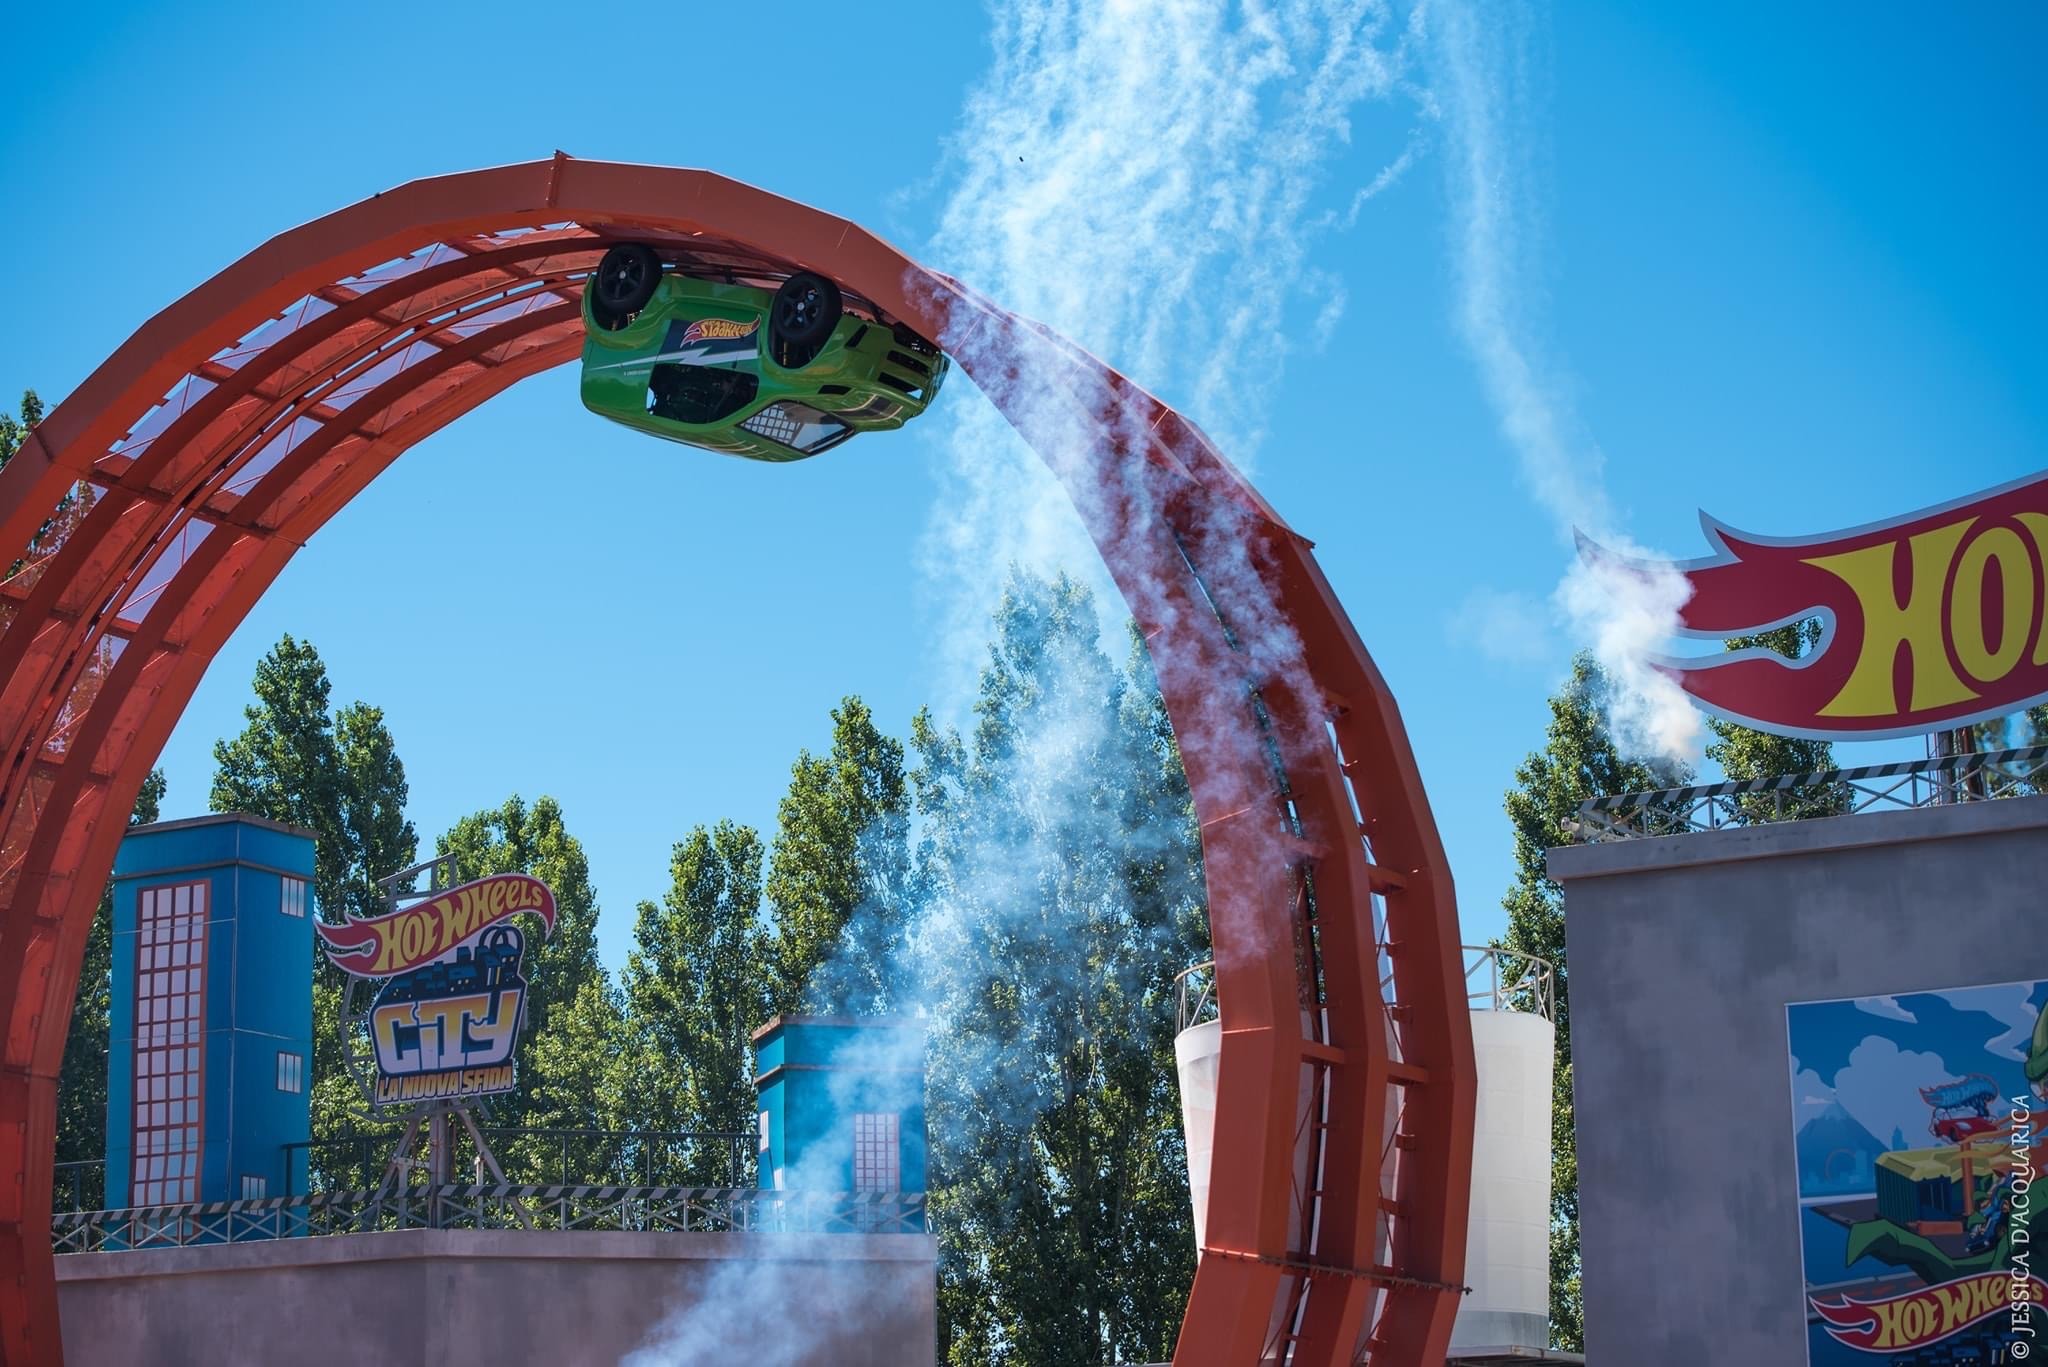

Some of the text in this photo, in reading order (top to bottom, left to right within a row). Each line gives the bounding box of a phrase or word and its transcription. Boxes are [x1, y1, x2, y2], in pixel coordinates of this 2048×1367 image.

[369, 880, 543, 971] HOT WHEELS
[377, 1065, 513, 1102] LA NUOVA SFIDA
[1866, 1298, 1939, 1348] HOT
